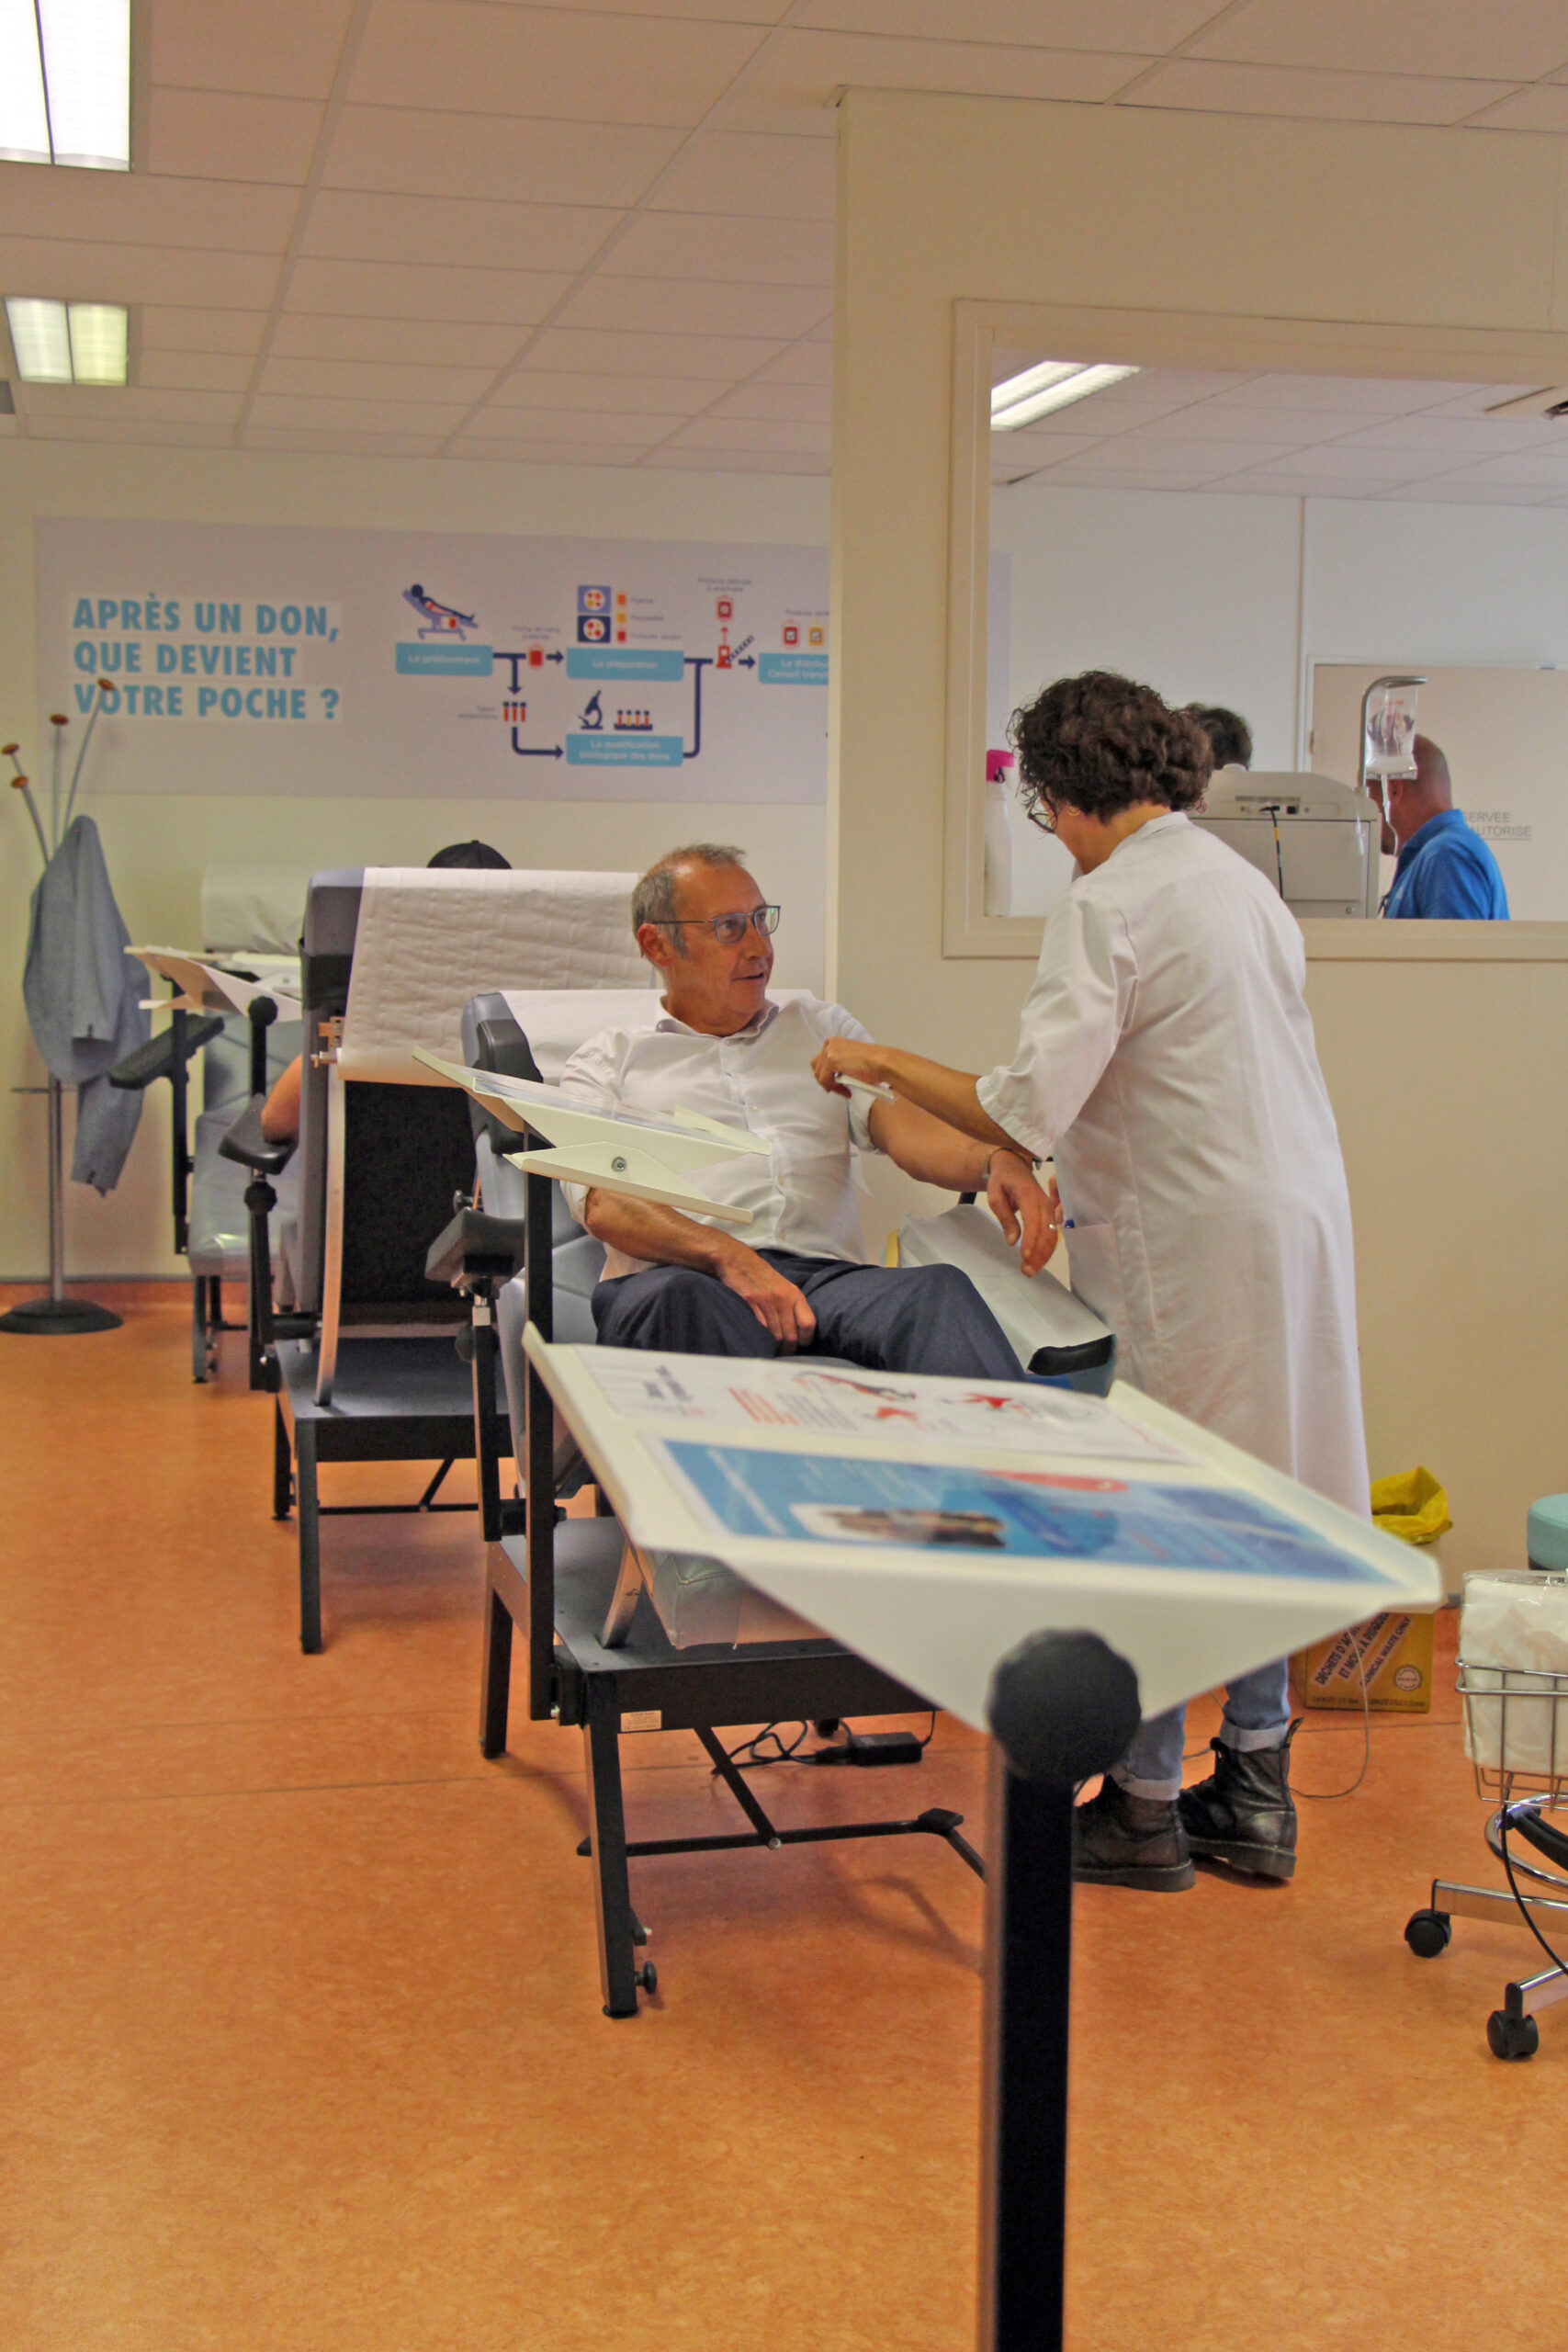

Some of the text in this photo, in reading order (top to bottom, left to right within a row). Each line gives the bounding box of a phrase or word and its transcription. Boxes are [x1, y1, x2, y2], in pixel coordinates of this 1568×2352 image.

[73, 592, 339, 643] APRÈS UN DON,
[73, 640, 297, 677] QUE DEVIENT
[73, 684, 340, 719] VOTRE POCHE ?
[1381, 1634, 1400, 1657] WASTE
[1395, 1617, 1411, 1635] ONLY
[1315, 1652, 1342, 1685] DECHETS
[1338, 1668, 1349, 1679] ET
[1359, 1640, 1371, 1648] A
